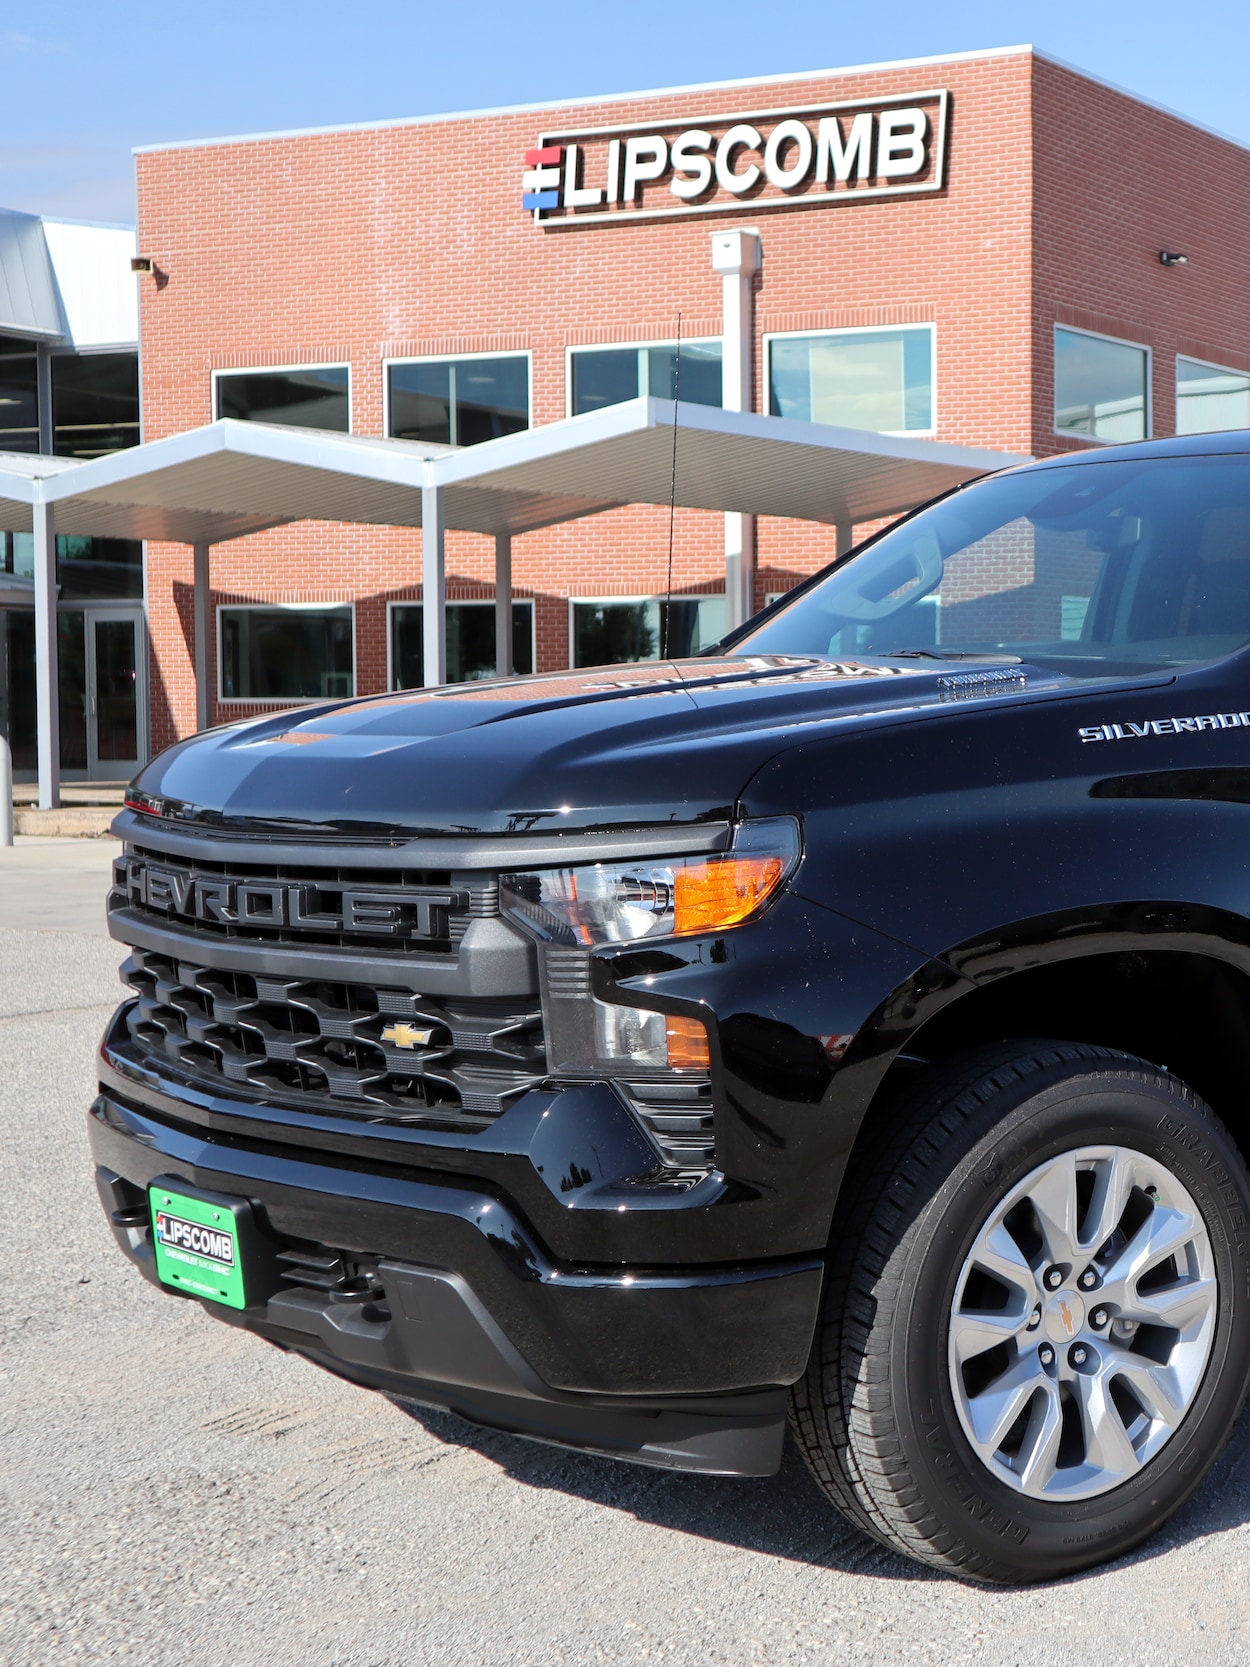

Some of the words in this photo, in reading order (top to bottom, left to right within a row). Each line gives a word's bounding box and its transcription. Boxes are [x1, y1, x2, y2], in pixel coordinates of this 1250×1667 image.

[563, 107, 928, 208] LIPSCOMB
[112, 857, 466, 936] CHEVROLET
[162, 1217, 232, 1260] LIPSCOMB
